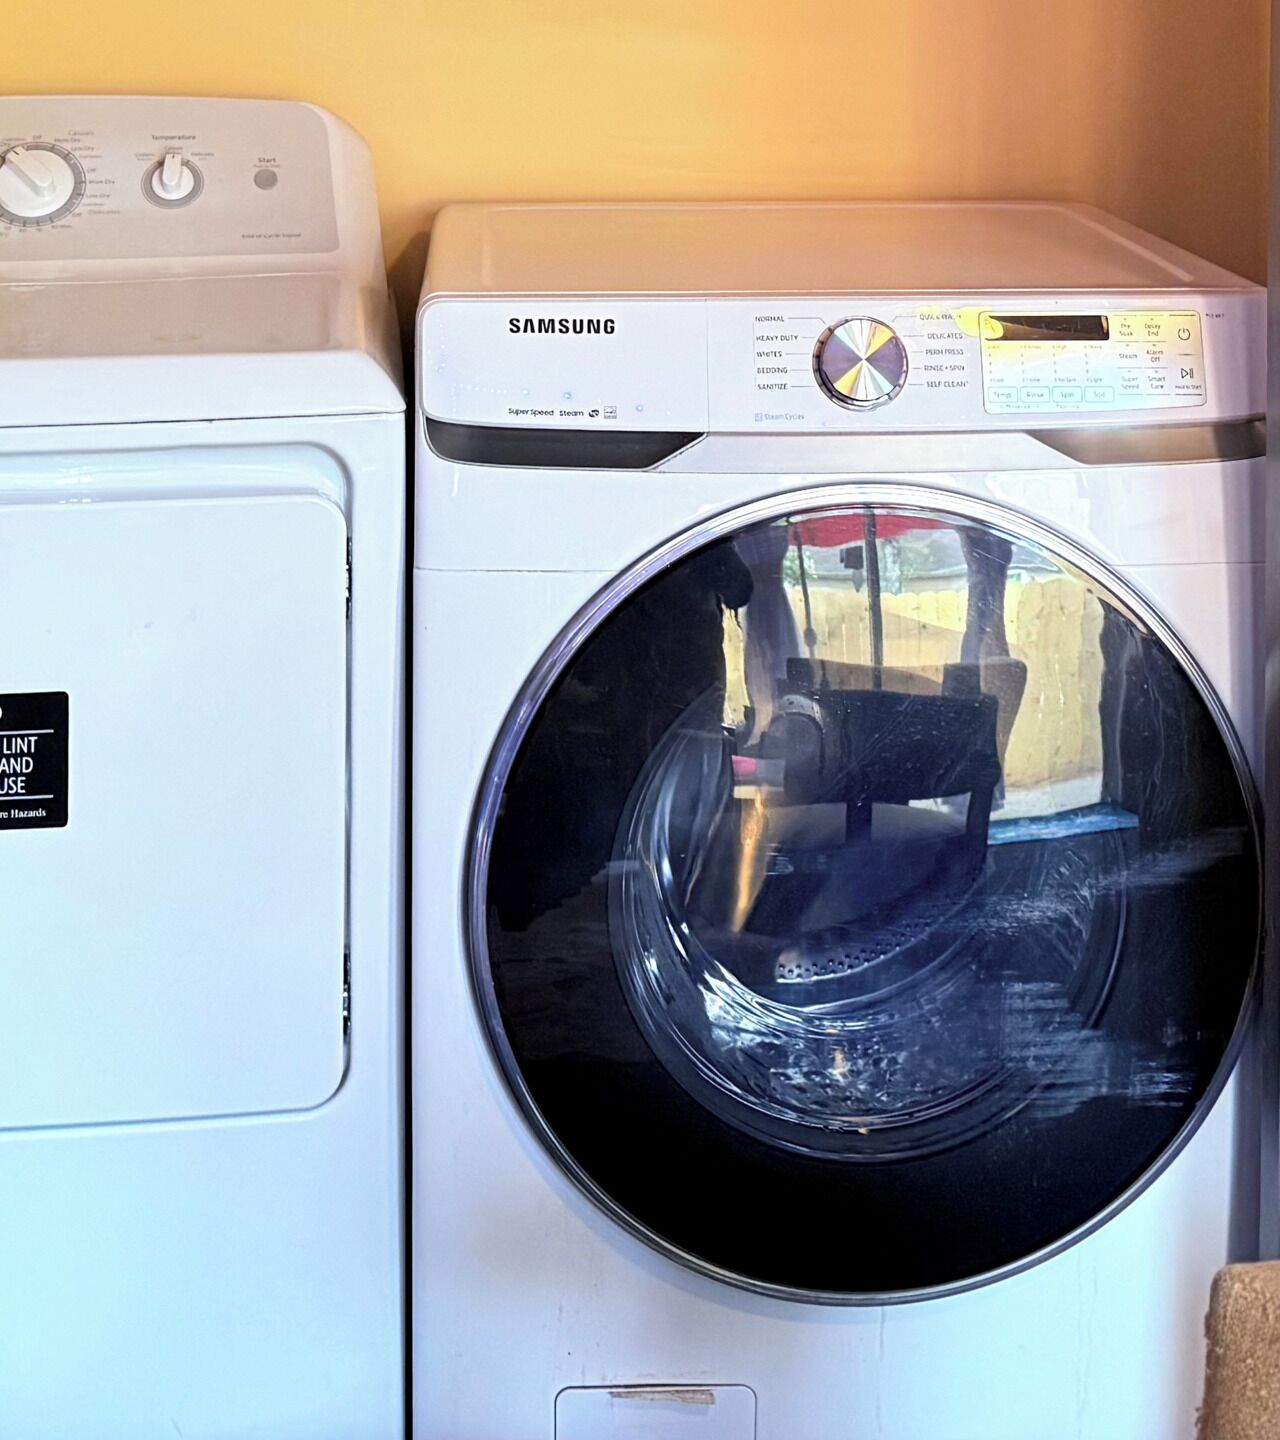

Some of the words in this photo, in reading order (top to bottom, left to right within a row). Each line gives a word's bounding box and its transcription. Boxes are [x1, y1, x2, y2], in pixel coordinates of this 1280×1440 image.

[508, 318, 616, 334] SAMSUNG
[3, 736, 38, 754] LINT
[10, 808, 46, 818] Hazards
